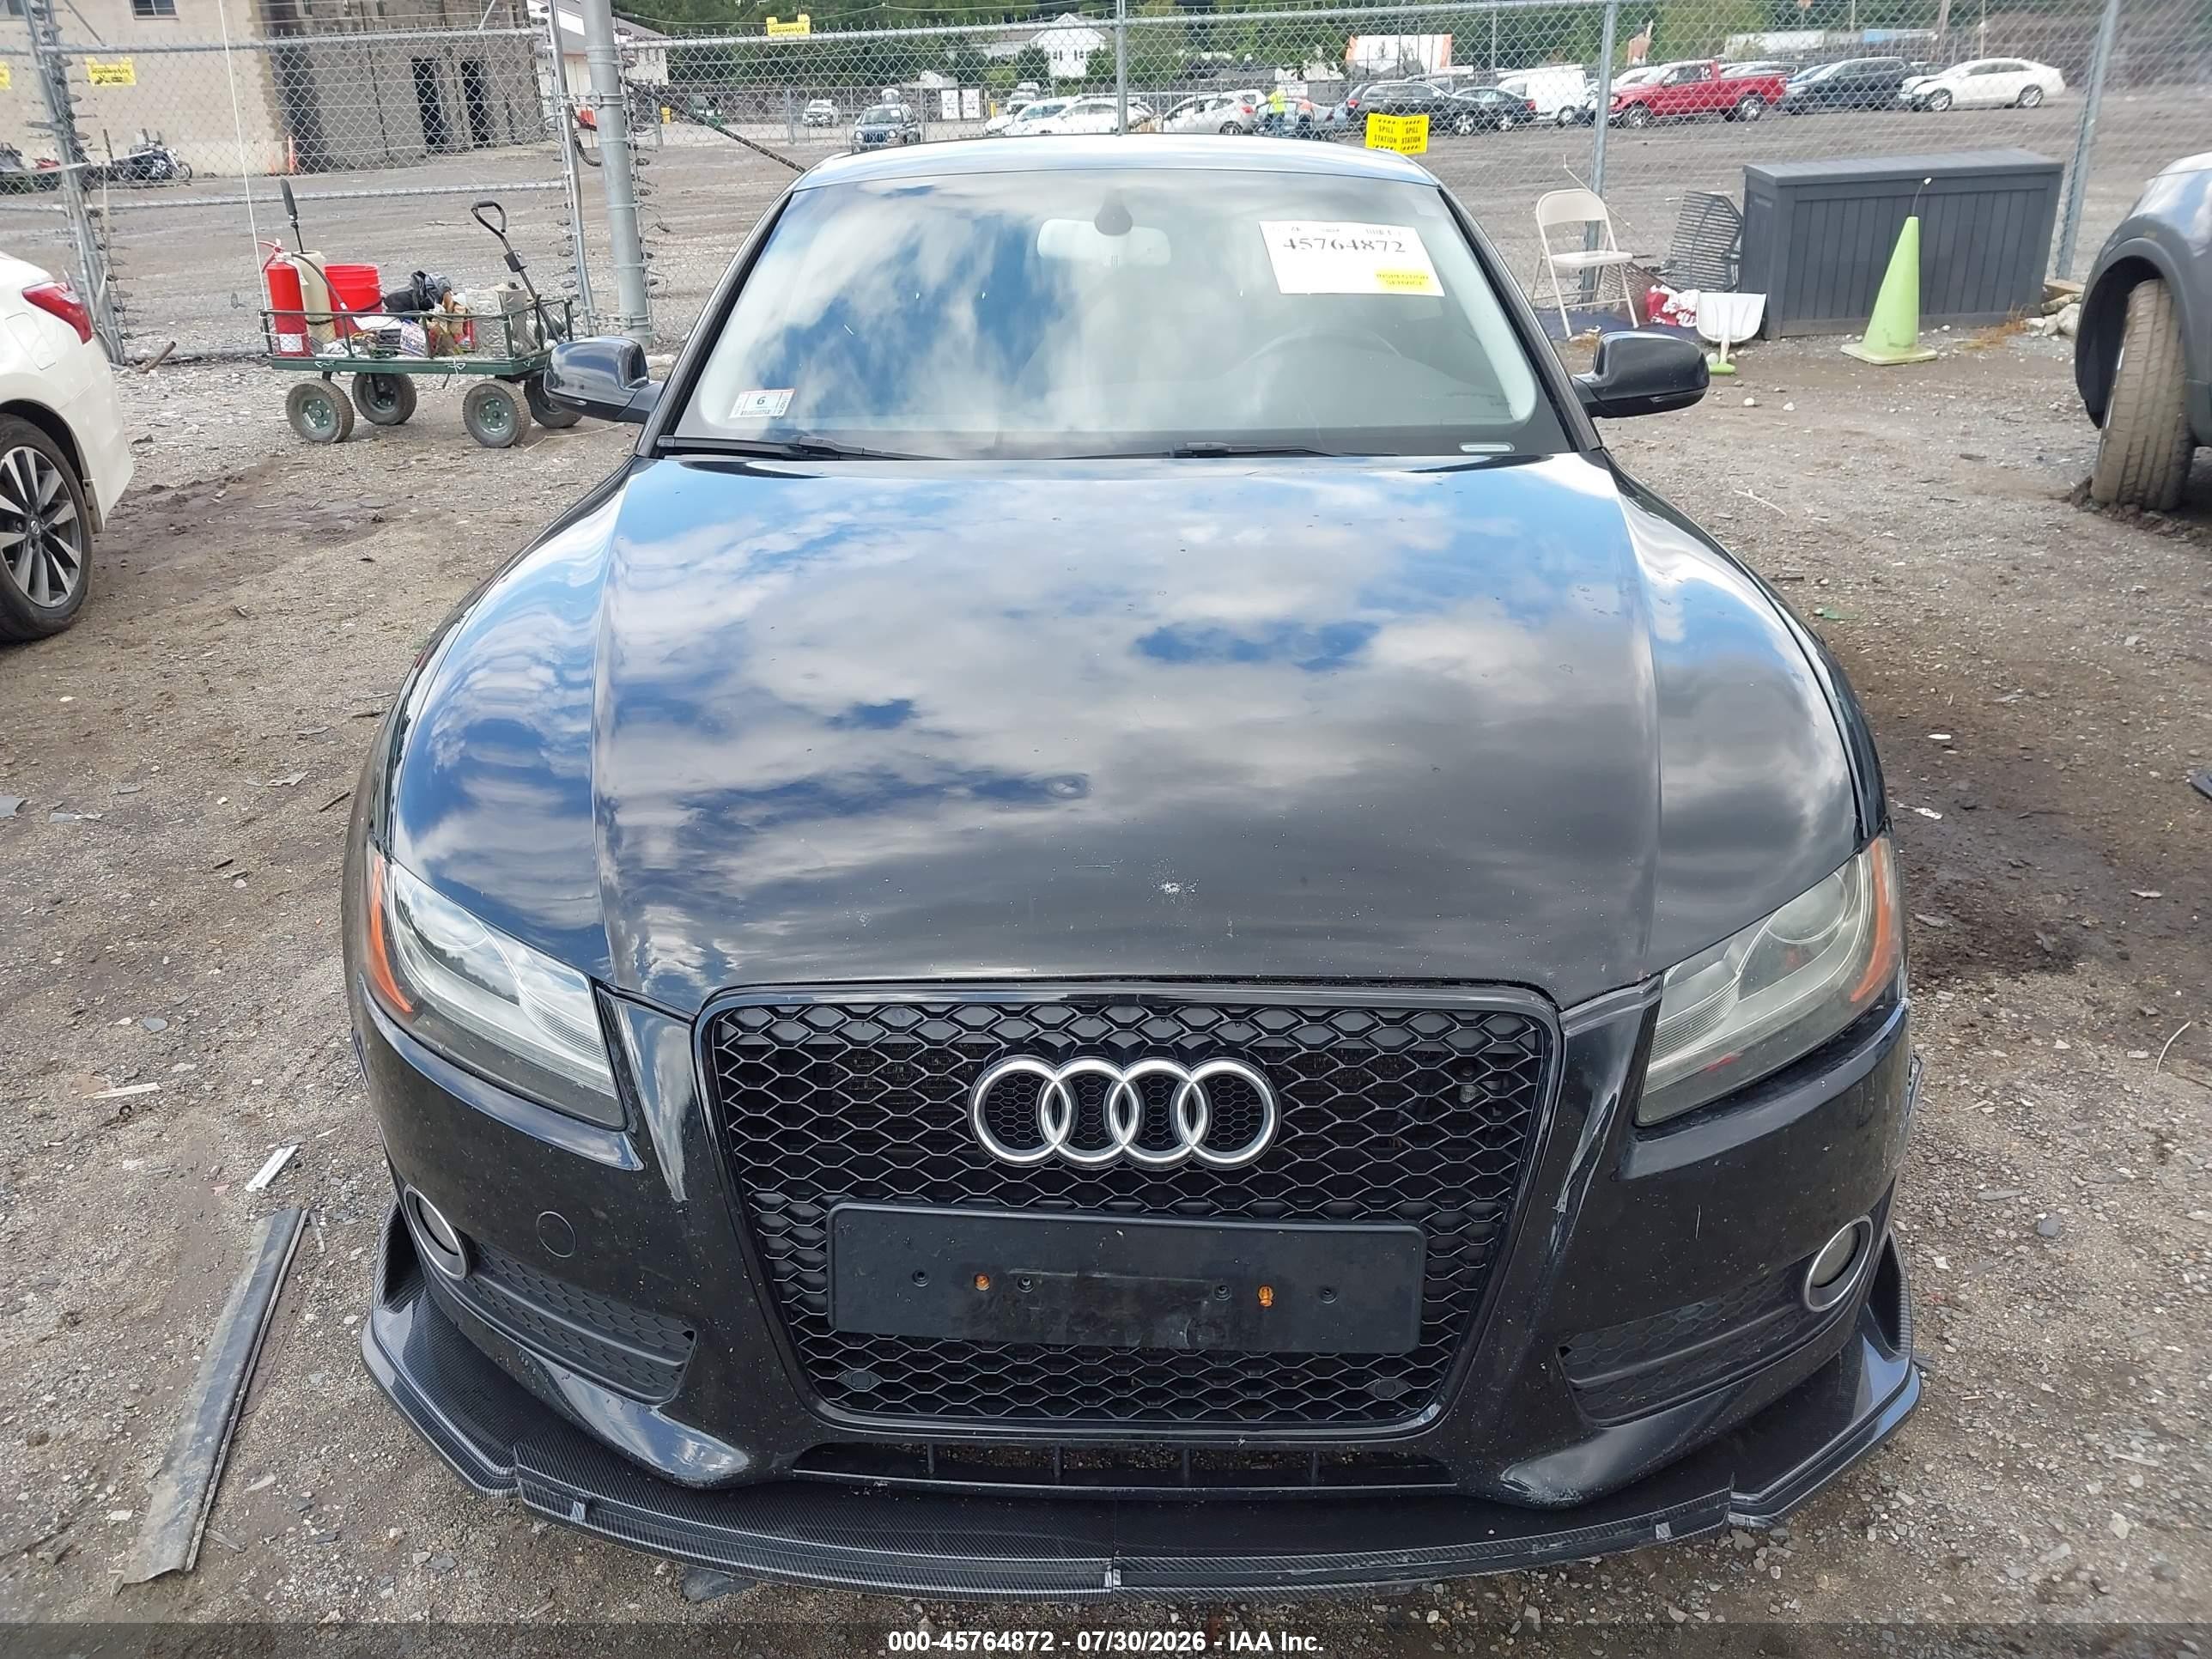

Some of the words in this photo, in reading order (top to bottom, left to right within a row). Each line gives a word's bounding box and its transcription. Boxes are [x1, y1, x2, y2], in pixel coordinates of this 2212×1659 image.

[1378, 125, 1394, 134] SPILL
[1374, 134, 1397, 144] STATION
[1401, 136, 1421, 144] STATION
[1283, 238, 1406, 253] 45764872
[757, 396, 767, 405] 6
